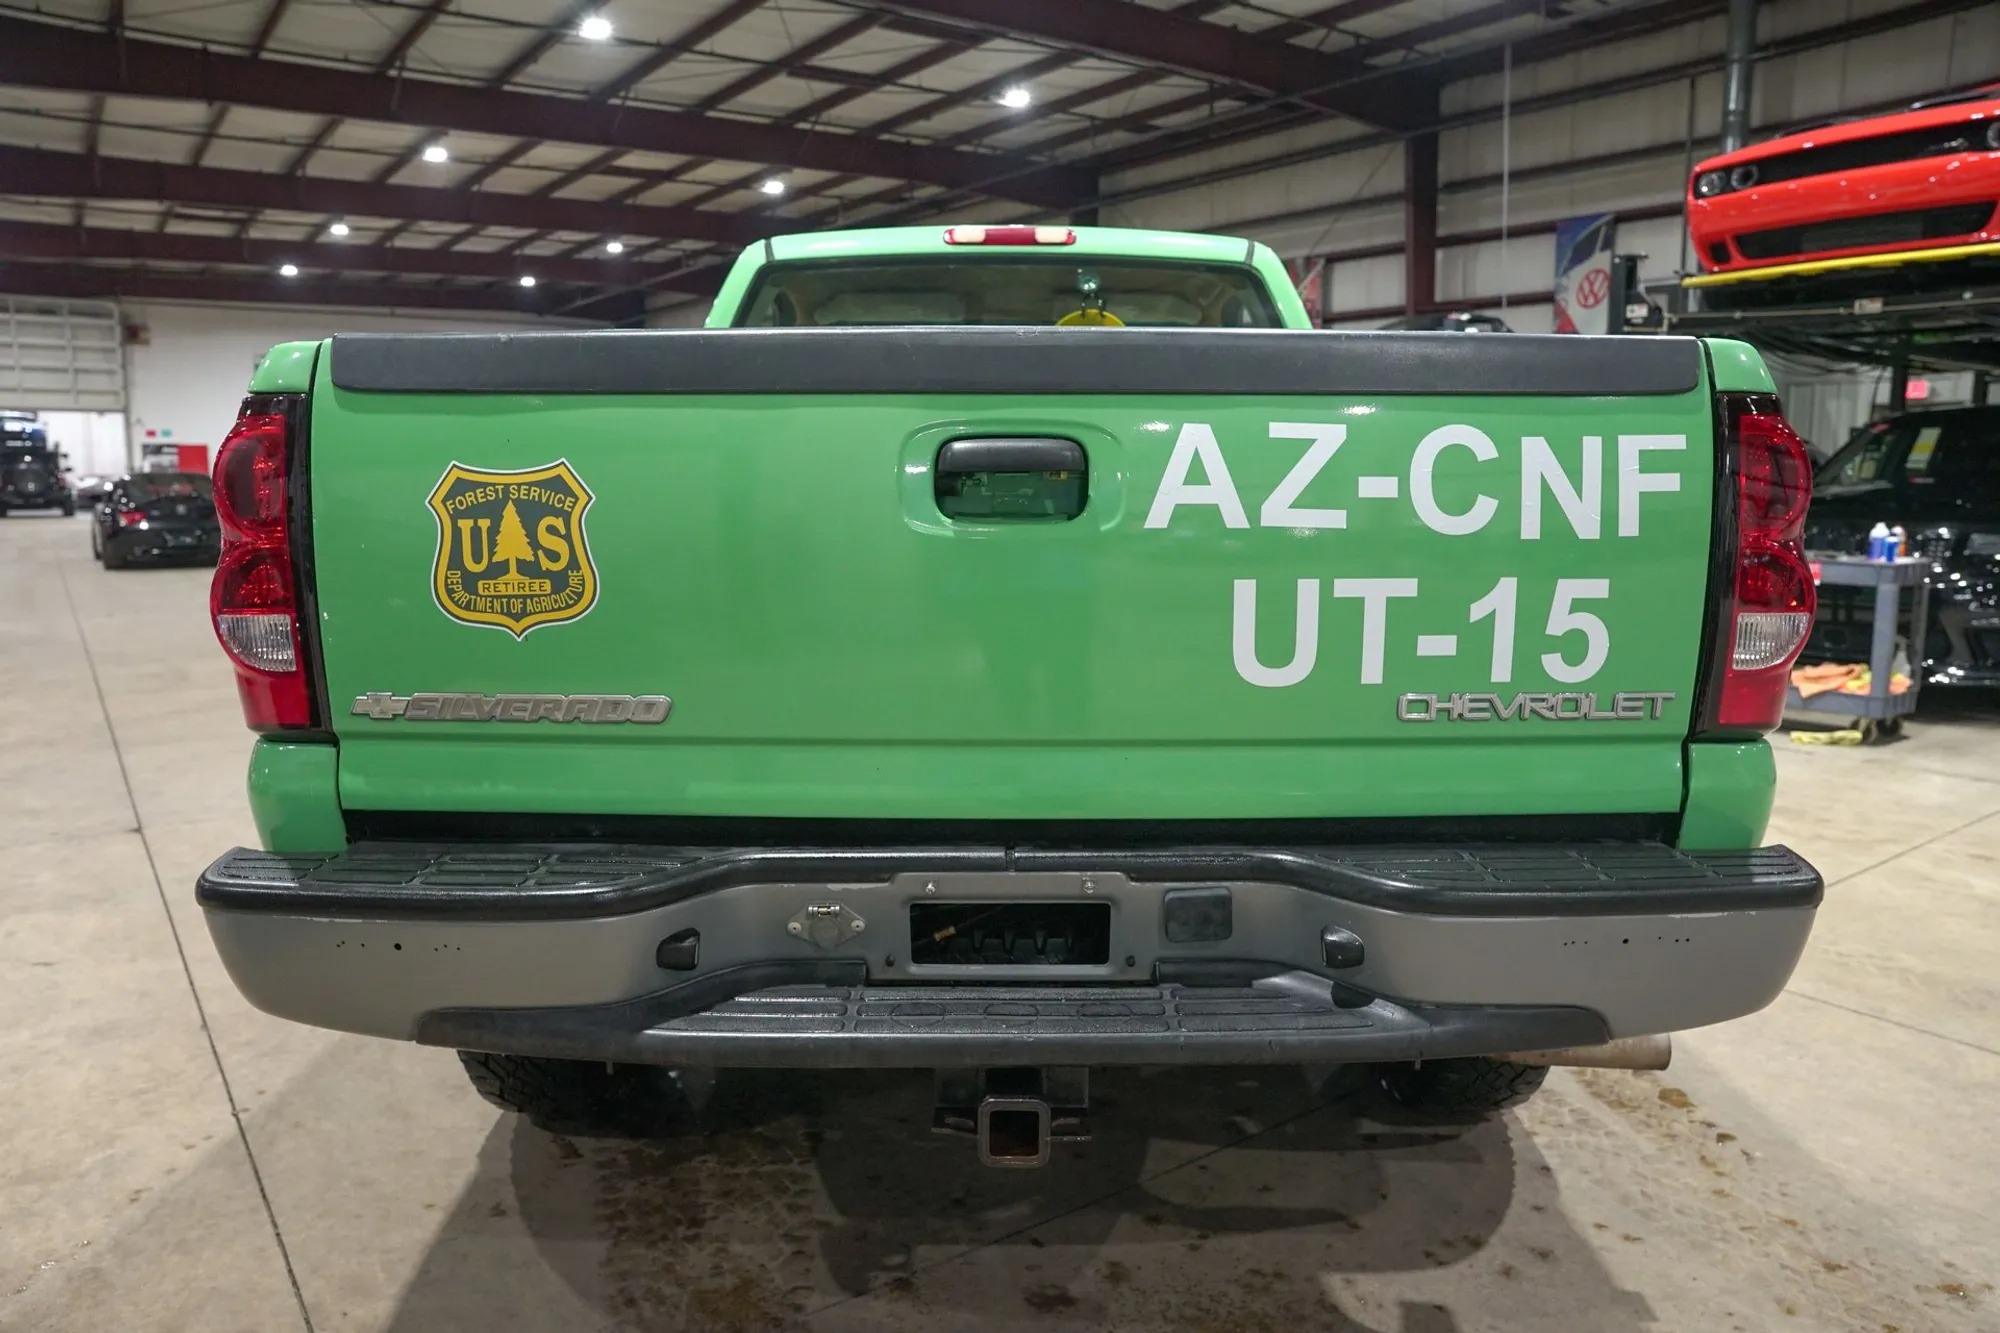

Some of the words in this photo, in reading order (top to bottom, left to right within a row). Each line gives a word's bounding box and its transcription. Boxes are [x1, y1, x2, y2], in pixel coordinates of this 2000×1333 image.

[1143, 421, 1687, 540] AZ-CNF
[446, 485, 504, 514] FOREST
[509, 485, 575, 512] SERVICE
[447, 570, 508, 613] DEPARTMENT
[510, 598, 524, 614] OF
[526, 569, 583, 613] AGRICULTURE
[482, 581, 548, 593] RETIREE
[1232, 577, 1610, 687] UT-15
[404, 692, 672, 724] SILVERADO
[1398, 692, 1676, 721] CHEVROLET
